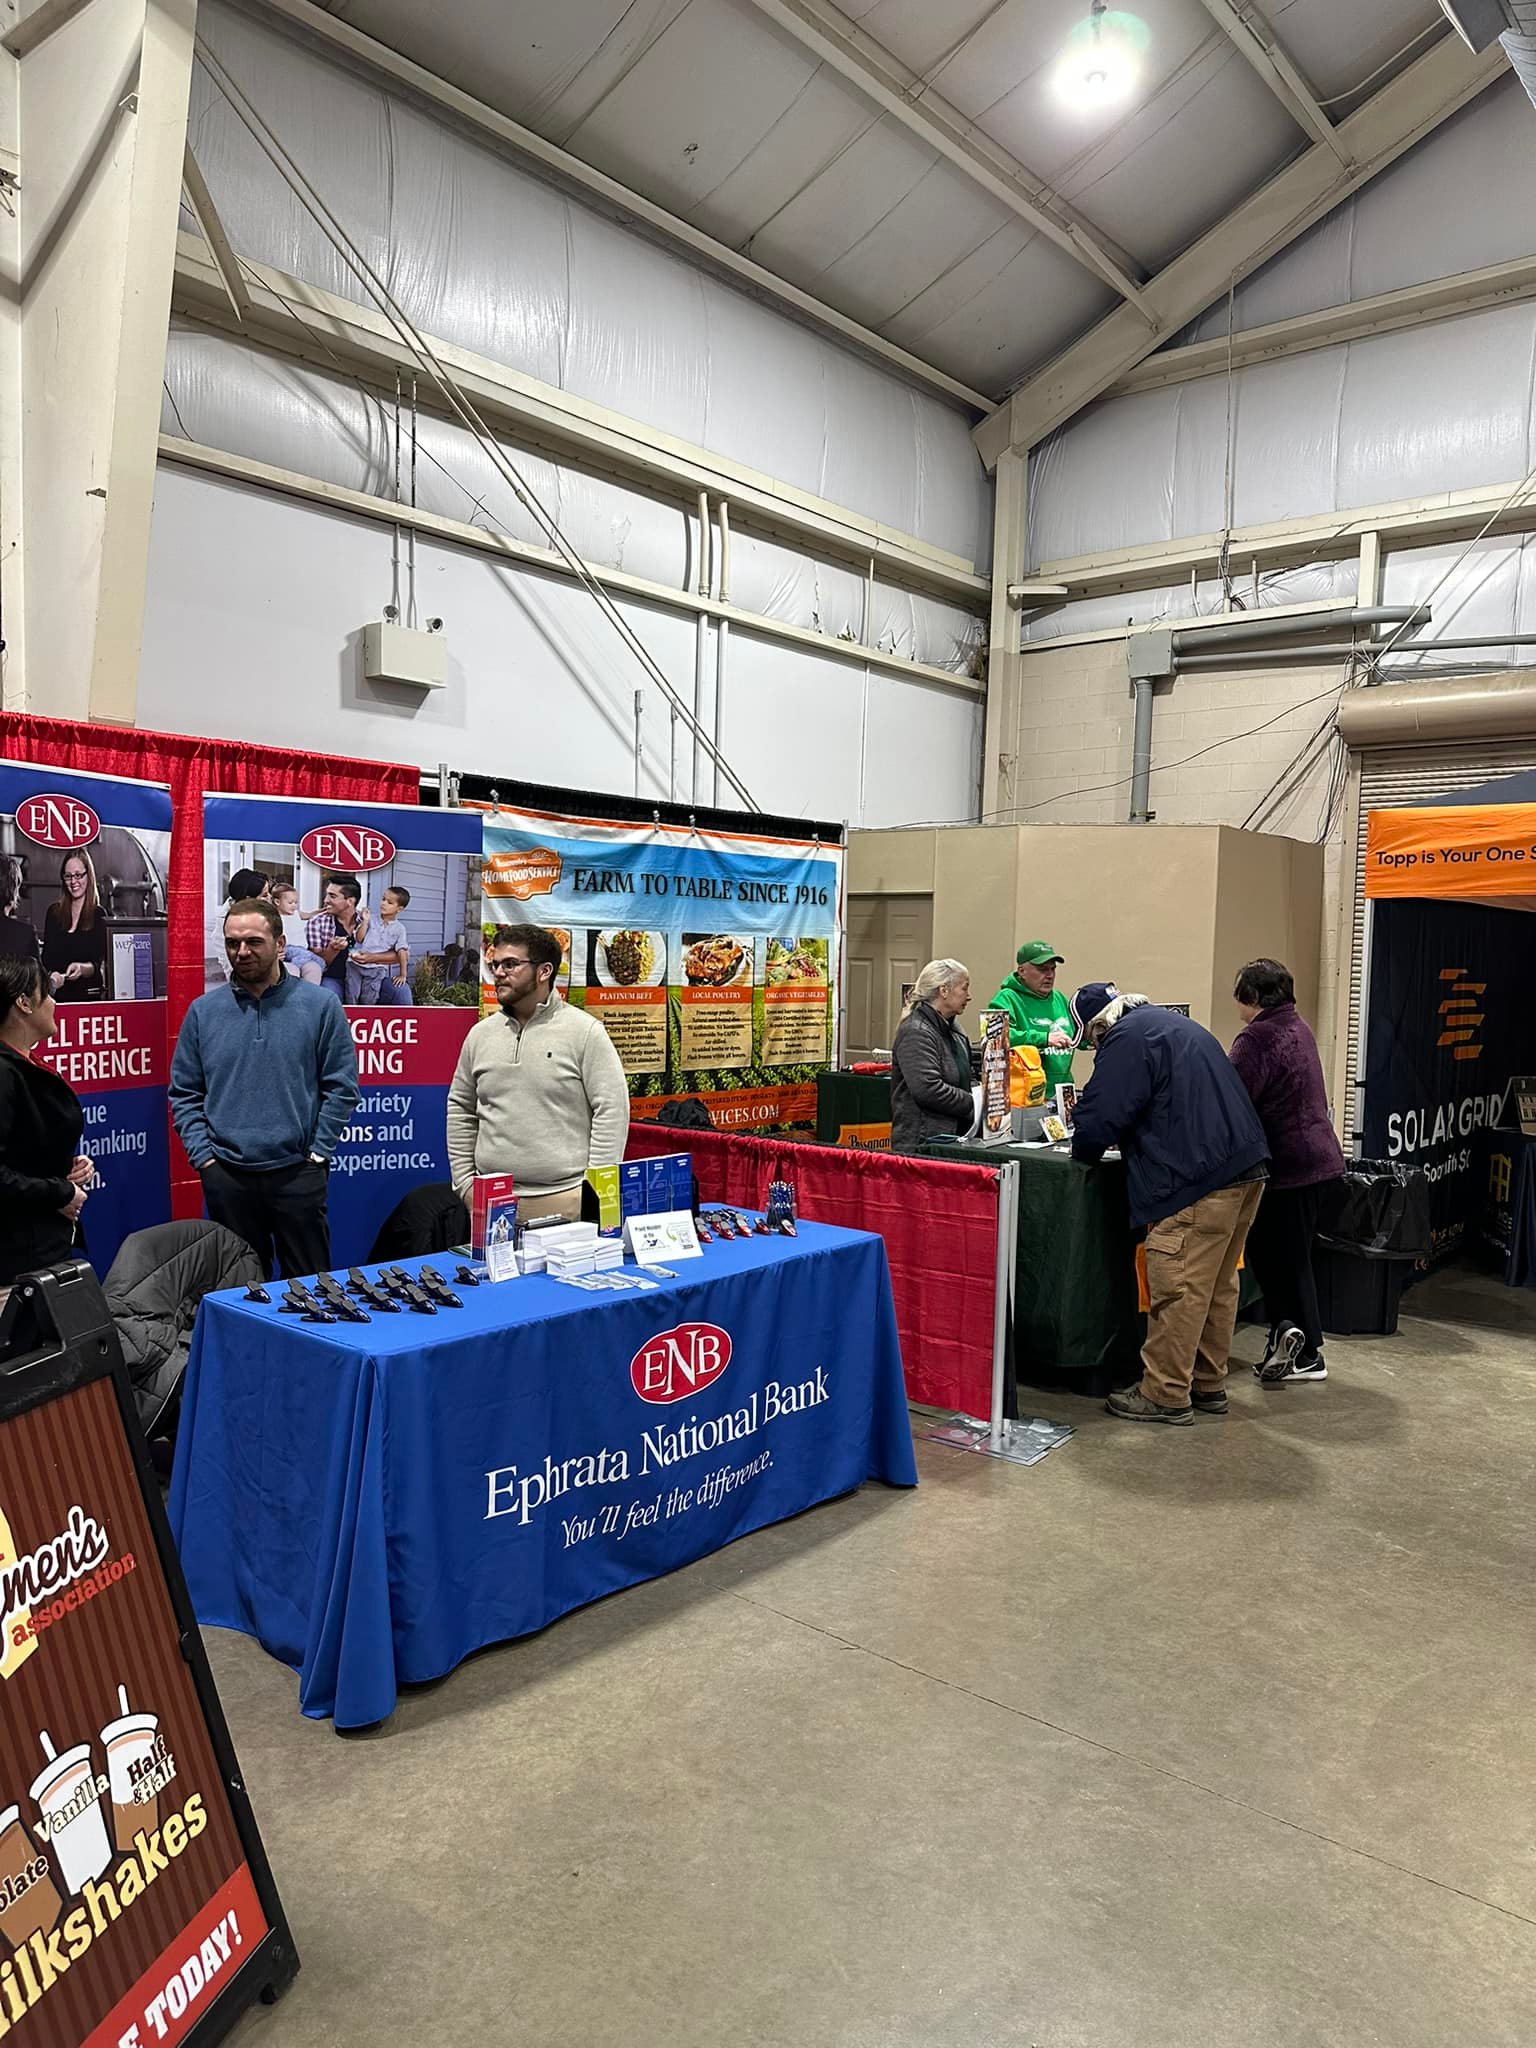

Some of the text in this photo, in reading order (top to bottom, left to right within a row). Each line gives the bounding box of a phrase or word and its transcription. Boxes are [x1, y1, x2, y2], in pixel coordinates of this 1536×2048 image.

[28, 799, 91, 843] ENB
[314, 829, 385, 867] ENB
[1376, 851, 1418, 868] Topp
[1422, 850, 1435, 864] is
[1440, 849, 1482, 863] Your
[1486, 847, 1526, 861] One
[573, 868, 828, 906] FARM TO TABLE SINCE 1916
[692, 991, 711, 999] LOCAL
[79, 1015, 128, 1046] FEEL
[348, 1018, 419, 1044] GAGE
[358, 1049, 403, 1074] ING
[377, 1119, 414, 1142] and
[1459, 1093, 1502, 1137] GRID
[80, 1128, 147, 1156] banking
[329, 1149, 436, 1177] experience.
[642, 1329, 721, 1396] ENB
[483, 1366, 830, 1525] Ephrata National Bank
[561, 1449, 774, 1549] You'll feel the difference.
[11, 1552, 137, 1646] association
[126, 1735, 167, 1787] Half
[33, 1774, 110, 1843] Vanilla
[144, 1909, 243, 2039] TODAY!
